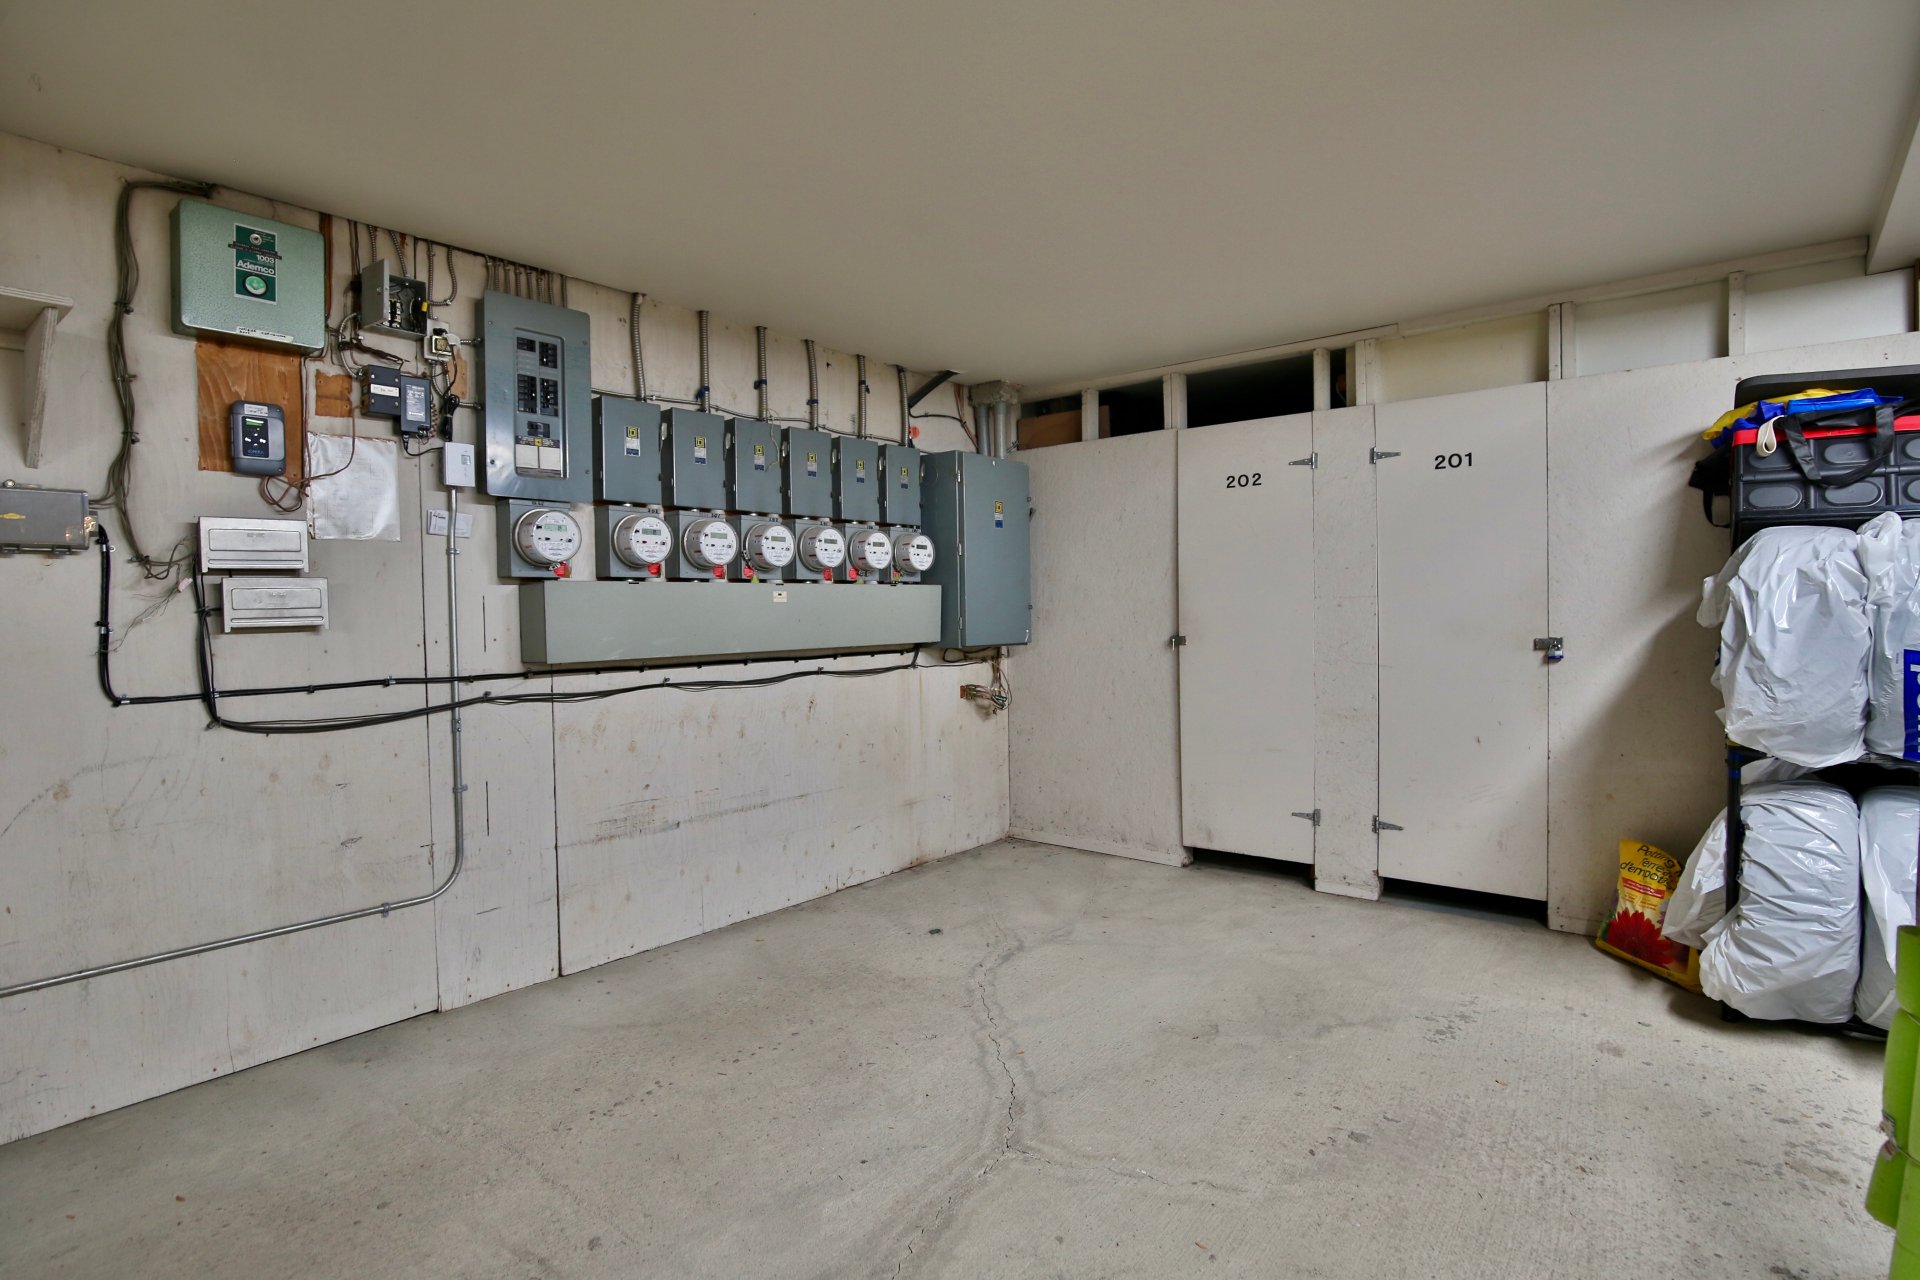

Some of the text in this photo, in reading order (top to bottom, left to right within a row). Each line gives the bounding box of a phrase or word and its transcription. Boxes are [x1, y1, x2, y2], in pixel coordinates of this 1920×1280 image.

[237, 260, 275, 275] Ademco
[256, 254, 275, 264] 1003
[1434, 452, 1473, 470] 201
[1226, 472, 1262, 489] 202
[1637, 845, 1675, 869] Potting
